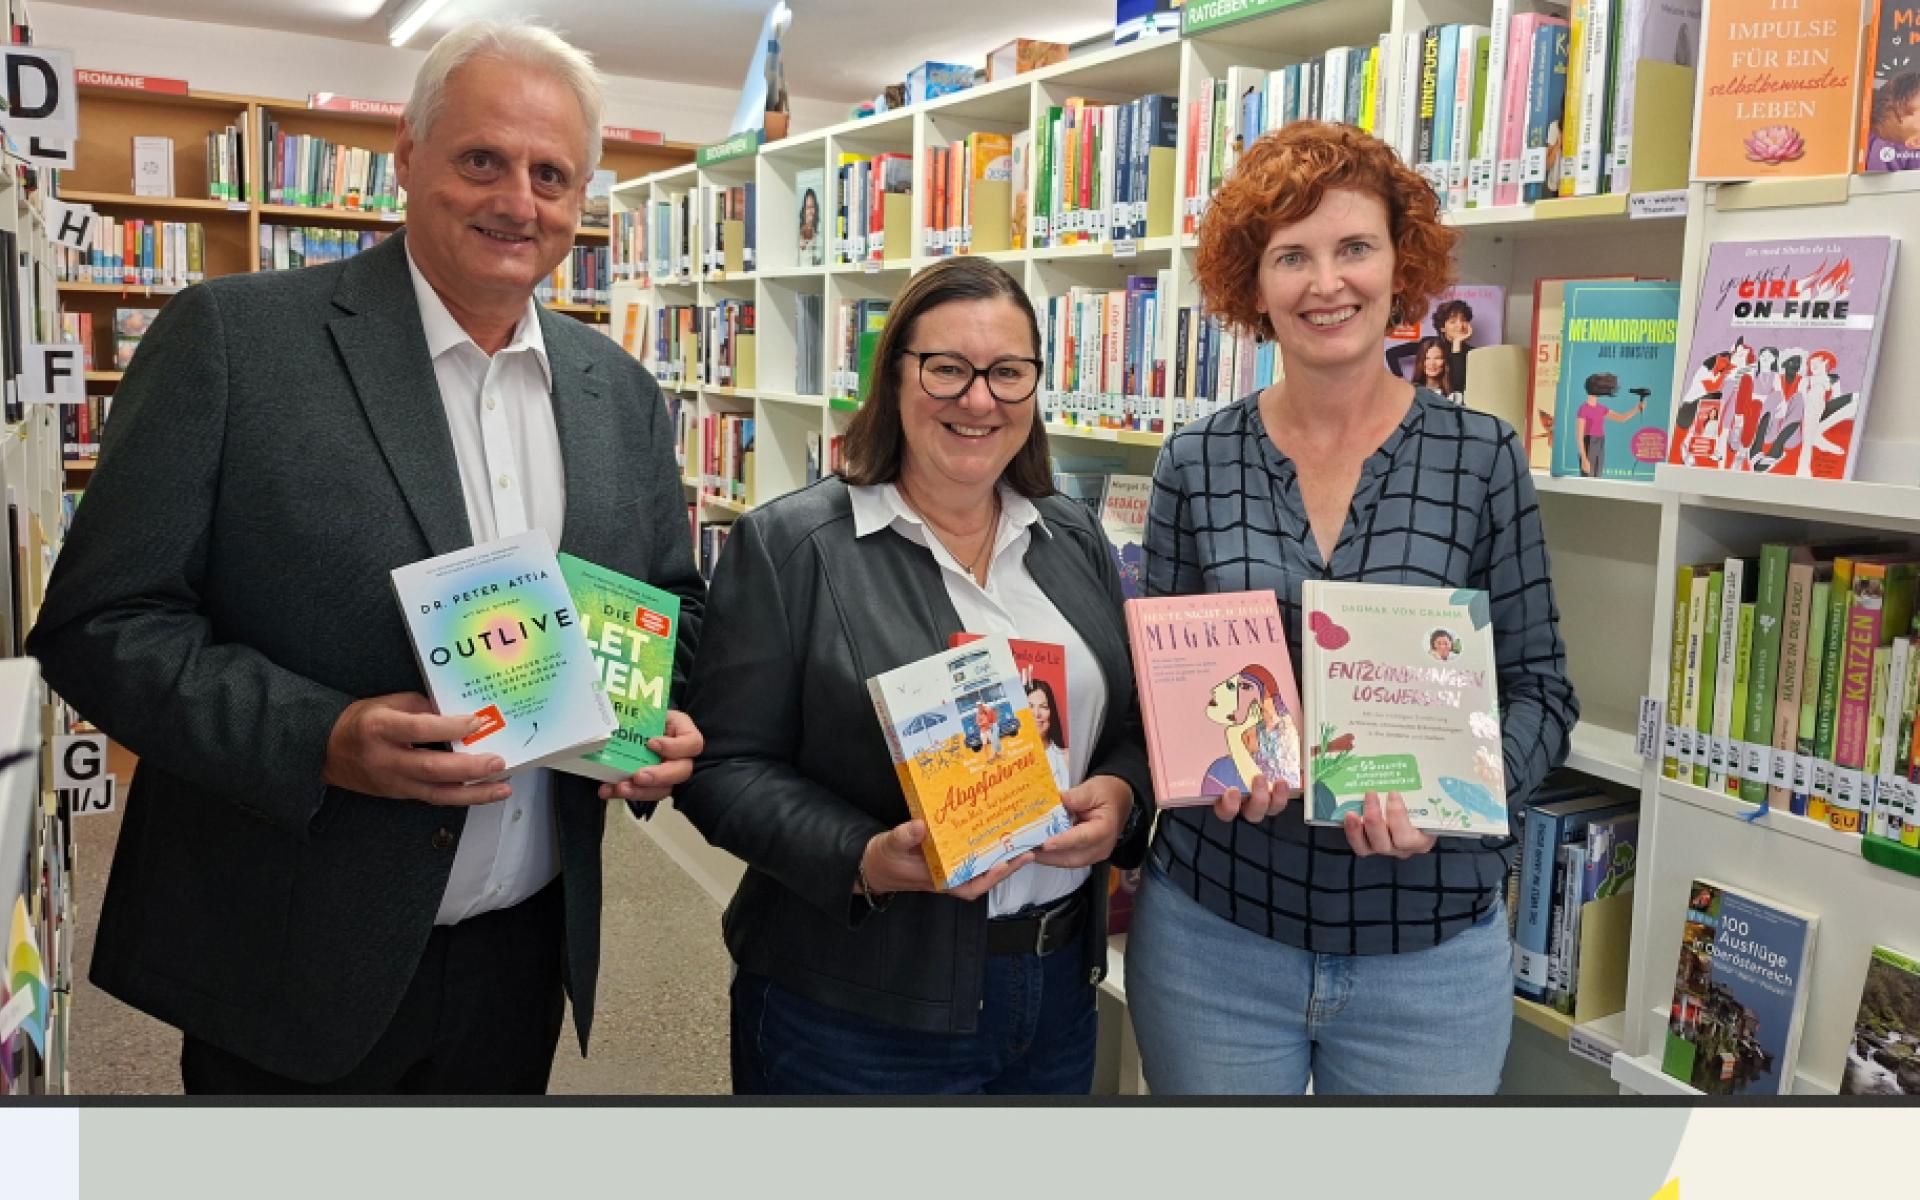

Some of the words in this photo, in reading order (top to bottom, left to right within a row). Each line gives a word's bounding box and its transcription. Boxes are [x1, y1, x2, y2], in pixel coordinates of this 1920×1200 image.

[1188, 0, 1248, 24] RATGEBER
[1727, 19, 1837, 41] IMPULSE
[1731, 48, 1779, 68] FÜR
[1786, 48, 1829, 67] EIN
[6, 54, 59, 119] D
[78, 71, 145, 89] ROMANE
[1420, 36, 1438, 119] MINDFUCK
[1709, 67, 1849, 97] selbstbewusstes
[1736, 100, 1816, 120] LEBEN
[58, 210, 90, 246] H
[1738, 279, 1801, 299] GIRL
[1735, 301, 1773, 318] ON
[1783, 301, 1850, 319] FIRE
[45, 350, 74, 394] F
[421, 600, 447, 614] DR.
[453, 583, 499, 604] PETER
[509, 570, 549, 589] ATTIA
[603, 604, 631, 623] DIE
[1341, 604, 1387, 614] DAGMAR
[1391, 607, 1416, 615] VON
[430, 607, 573, 666] OUTLIVE
[580, 613, 651, 663] LET
[1146, 616, 1279, 651] MIGRÄNE
[1846, 614, 1873, 701] KATZEN
[64, 741, 100, 780] G
[1831, 812, 1856, 828] GU
[1534, 849, 1543, 872] JAHR
[1530, 888, 1541, 909] WELT
[1721, 915, 1749, 936] 100
[1719, 930, 1788, 969] Ausflüge
[1705, 943, 1793, 986] Oberösterreich
